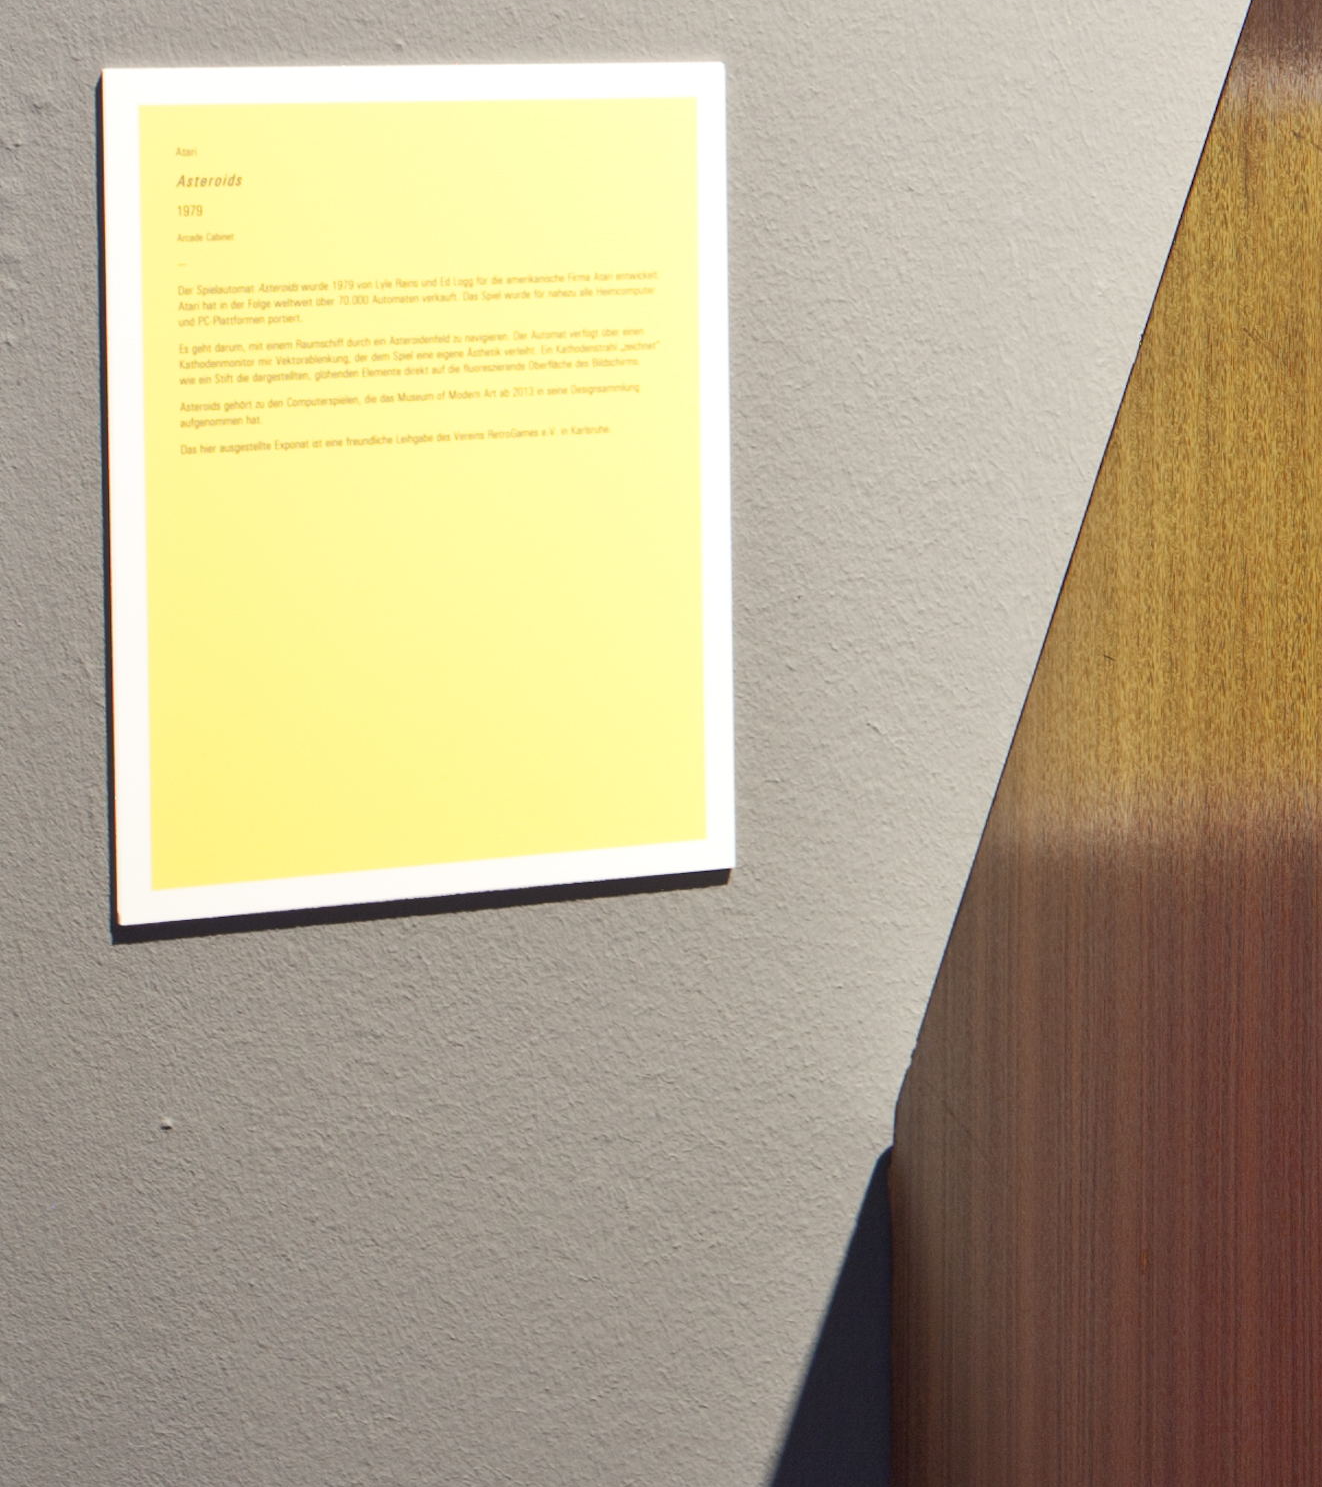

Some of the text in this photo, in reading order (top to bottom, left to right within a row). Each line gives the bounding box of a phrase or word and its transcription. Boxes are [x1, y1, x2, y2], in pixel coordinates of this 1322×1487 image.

[175, 146, 198, 157] Atari
[176, 173, 243, 188] Asteroids
[177, 205, 203, 217] 1979
[177, 232, 235, 243] Arcade Cabinet
[177, 284, 193, 296] Der
[196, 282, 255, 297] Spielautomat
[257, 281, 298, 293] Asteroids
[300, 280, 329, 292] wurde
[332, 279, 354, 290] 1979
[356, 281, 372, 290] von
[395, 277, 419, 288] Rains
[420, 277, 437, 287] und
[439, 275, 450, 287] Ed
[452, 275, 474, 288] Logg
[490, 274, 503, 285] die
[505, 272, 565, 284] amerikanische
[567, 271, 590, 282] Firma
[593, 271, 613, 281] Atari
[177, 300, 200, 311] Atari
[201, 299, 217, 310] hat
[219, 299, 228, 309] in
[229, 298, 245, 309] der
[247, 297, 271, 310] Folge
[273, 296, 313, 308] weltweit
[315, 295, 335, 306] über
[371, 292, 419, 304] Automaten
[462, 290, 478, 301] Das
[480, 289, 501, 302] Spiel
[503, 289, 531, 300] wurde
[547, 287, 577, 298] nahezu
[578, 287, 593, 297] alle
[177, 316, 195, 327] und
[179, 400, 221, 412] Asteroids
[223, 399, 252, 412] gehört
[254, 400, 265, 409] zu
[267, 397, 284, 408] den
[363, 393, 377, 404] die
[379, 392, 395, 403] das
[397, 390, 434, 402] Museum
[436, 389, 445, 400] of
[447, 388, 481, 400] Modern
[483, 387, 497, 398] Art
[499, 387, 510, 398] ab
[512, 385, 534, 397] 2013
[546, 386, 568, 395] seine
[570, 381, 640, 396] Designsammlung
[179, 414, 243, 430] aufgenommen
[180, 443, 197, 455] Das
[199, 443, 216, 454] hier
[218, 439, 272, 455] ausgestellte
[273, 437, 309, 451] Exponat
[311, 438, 323, 448] ist
[324, 438, 343, 447] eine
[345, 433, 393, 447] freundliche
[395, 432, 434, 446] Leihgabe
[435, 431, 451, 442] des
[453, 429, 485, 441] Vereins
[487, 426, 539, 440] RetroGames
[560, 427, 568, 435] in
